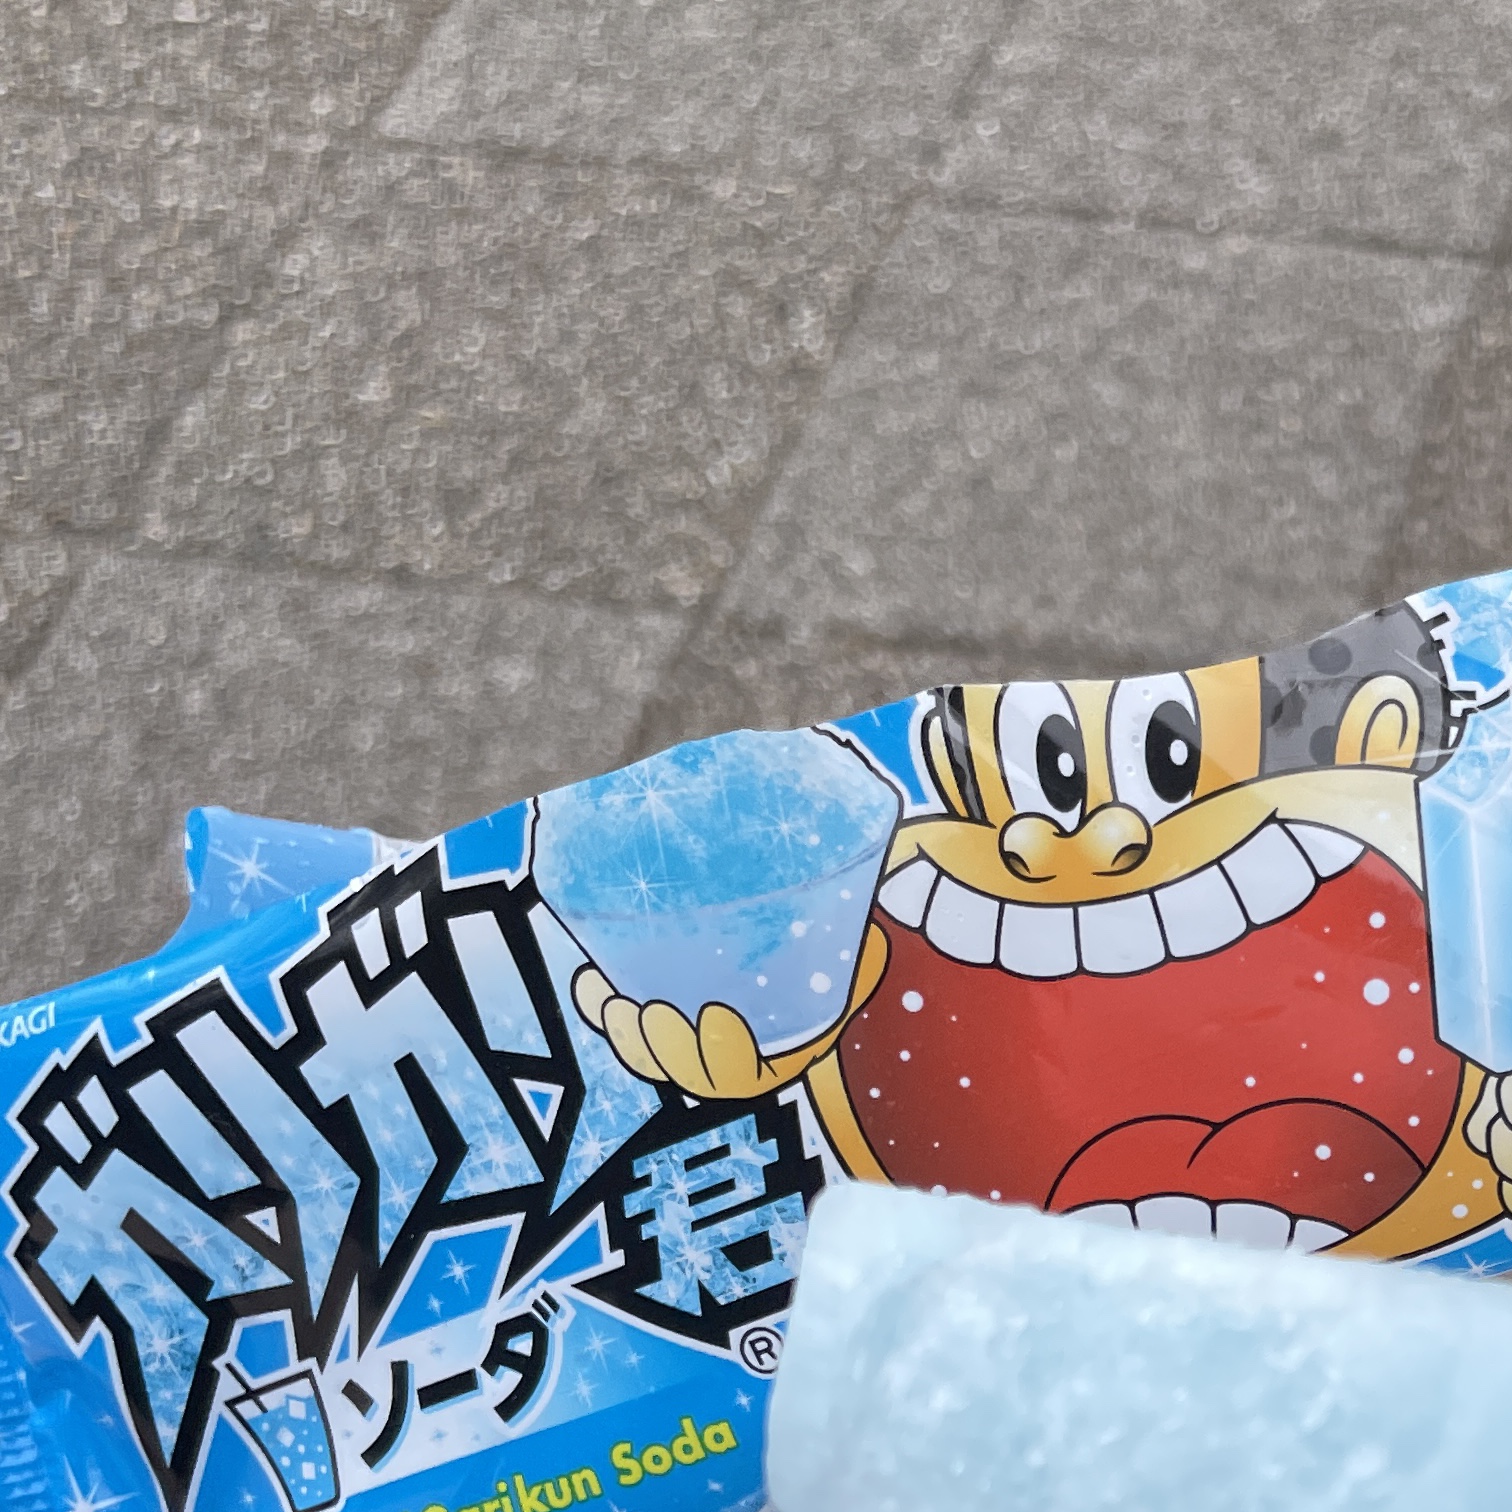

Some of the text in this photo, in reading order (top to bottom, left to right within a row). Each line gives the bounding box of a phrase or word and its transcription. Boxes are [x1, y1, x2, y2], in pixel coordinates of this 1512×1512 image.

[341, 1290, 562, 1471] ソーダ
[609, 1415, 739, 1487] Soda
